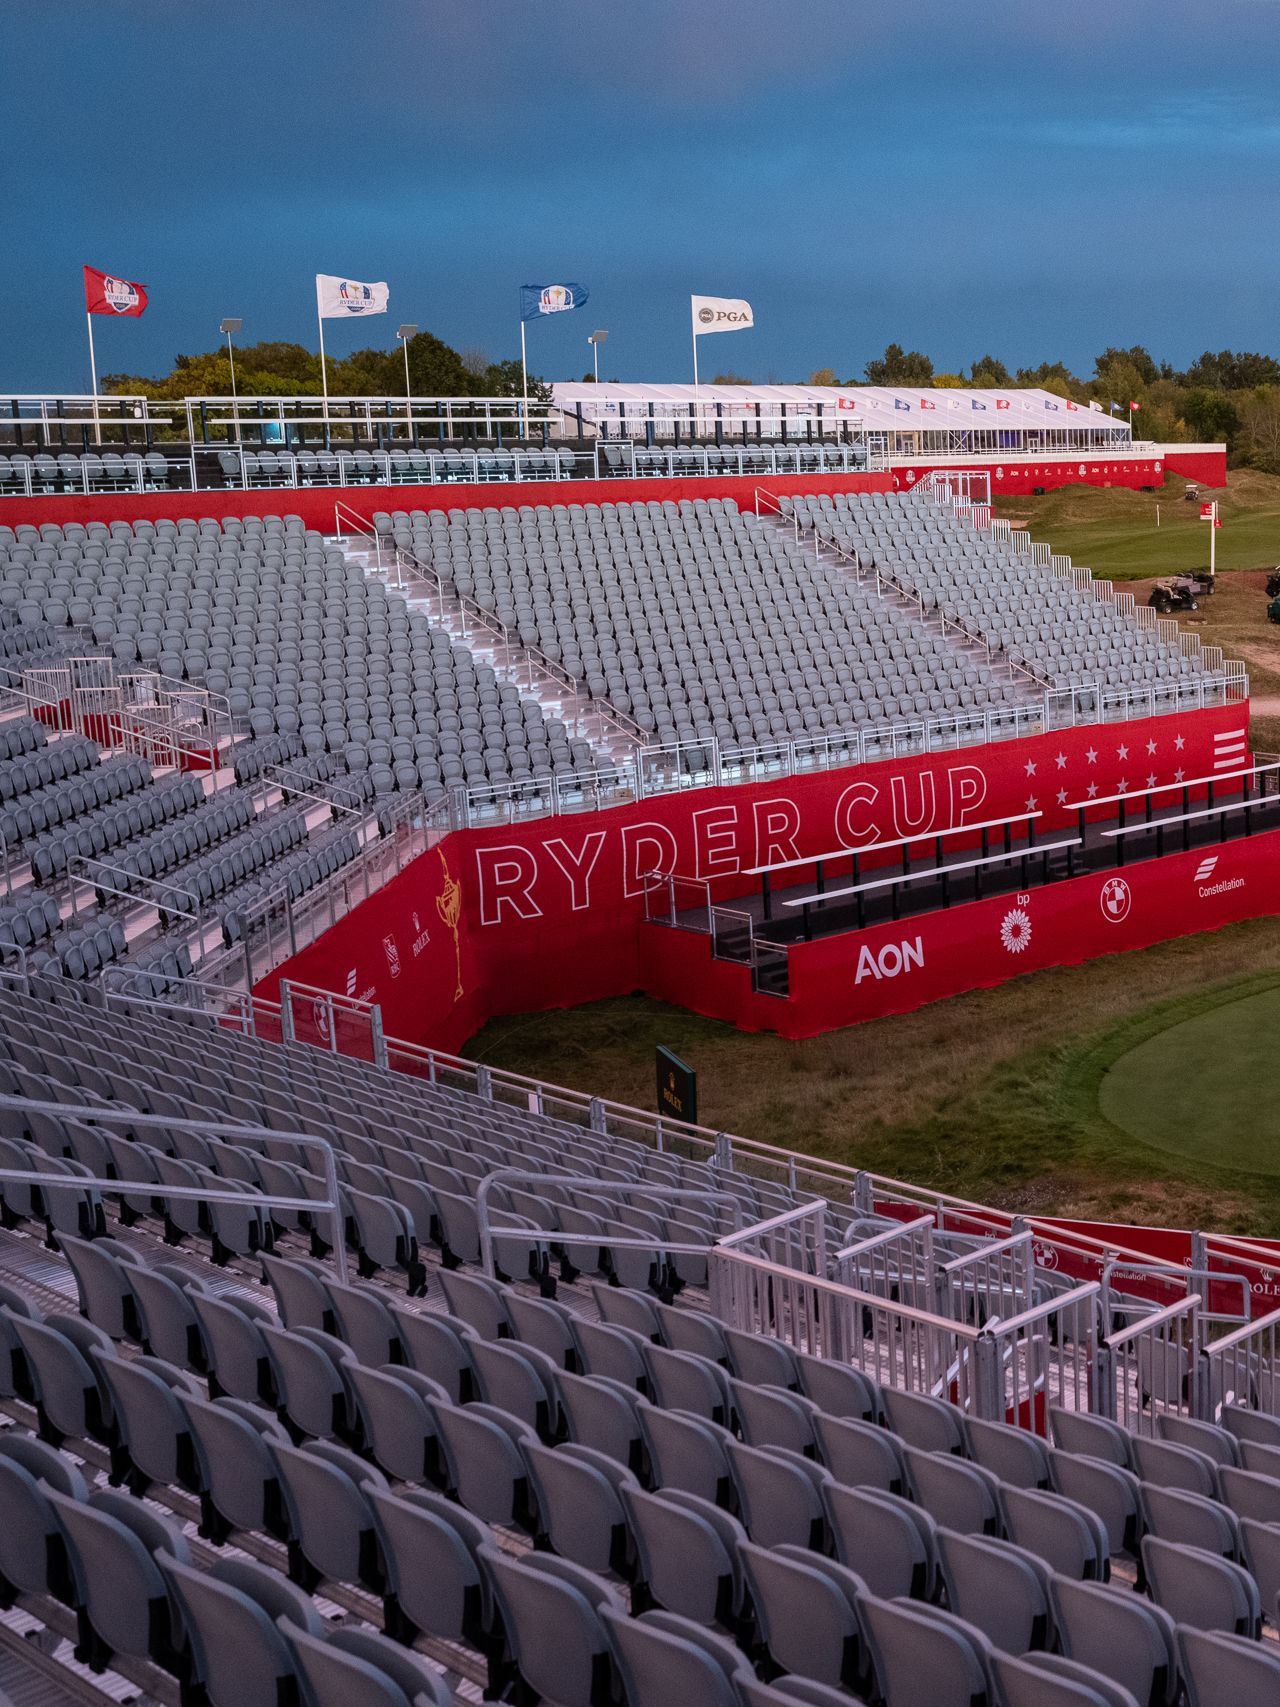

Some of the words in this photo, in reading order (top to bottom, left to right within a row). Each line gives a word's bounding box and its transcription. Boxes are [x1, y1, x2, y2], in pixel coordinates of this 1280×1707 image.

[716, 311, 750, 322] PGA
[476, 797, 802, 927] RYDER
[834, 764, 988, 849] CUP
[1104, 880, 1127, 895] BMW
[1198, 877, 1245, 898] Constellation
[1017, 893, 1030, 907] bp
[413, 929, 430, 957] ROLEX
[854, 936, 925, 985] AON
[663, 1087, 682, 1112] ROLEX
